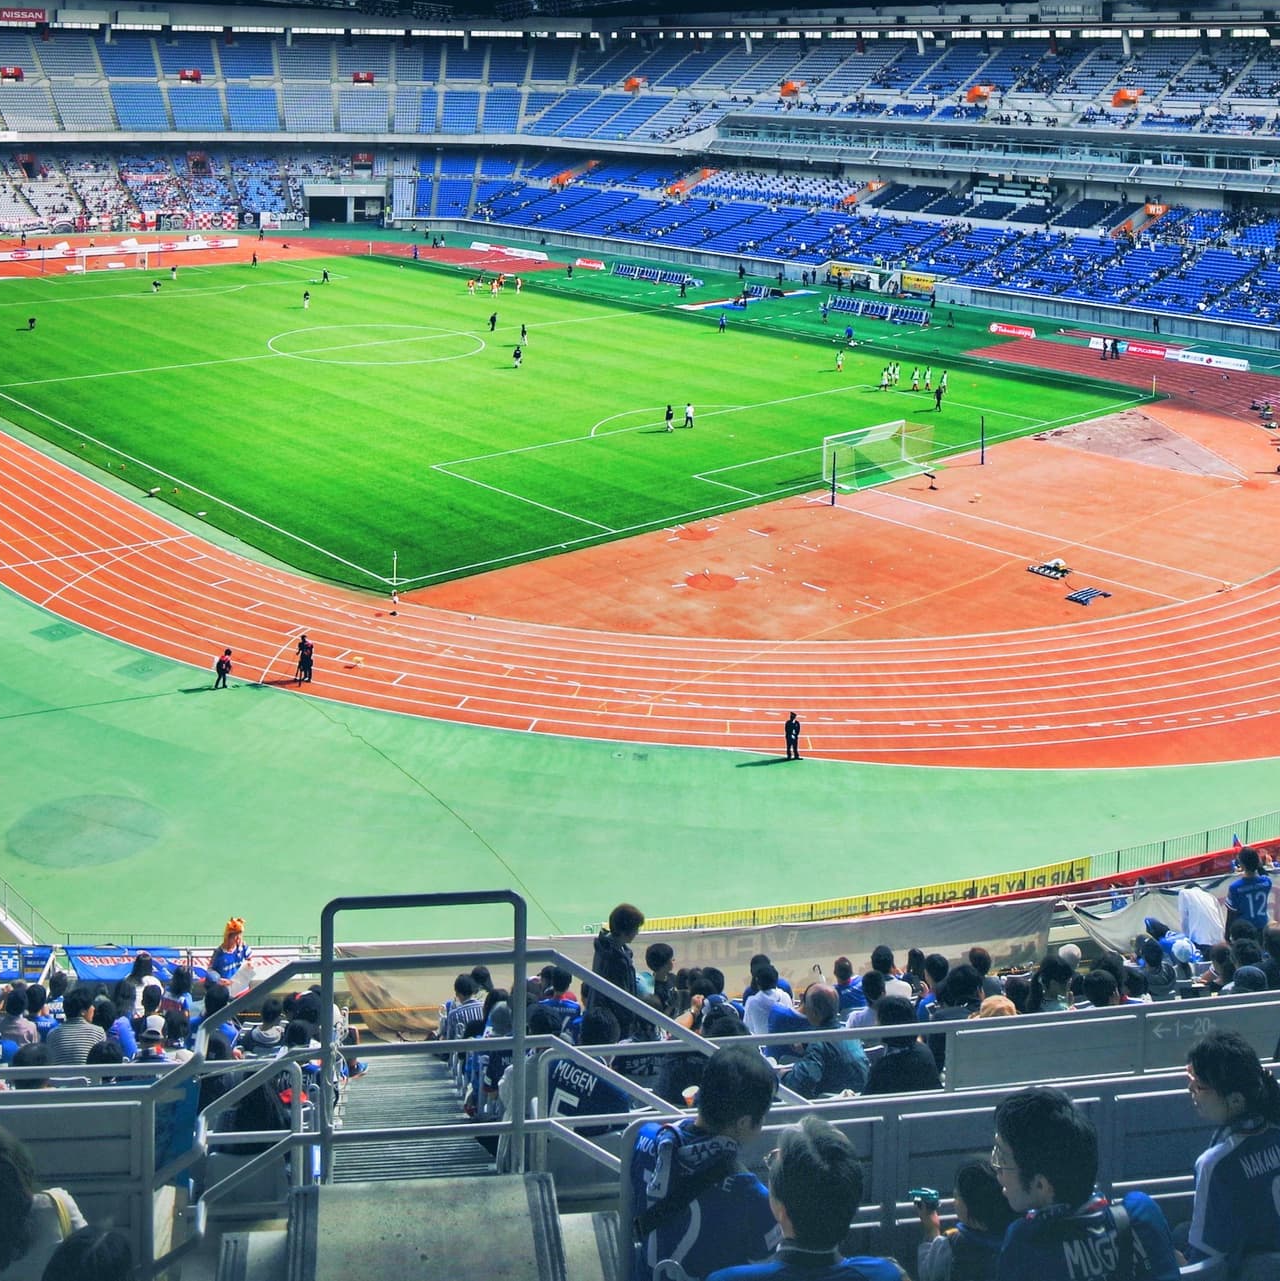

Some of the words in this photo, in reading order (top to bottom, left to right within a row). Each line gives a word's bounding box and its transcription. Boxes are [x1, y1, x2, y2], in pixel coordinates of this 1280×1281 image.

[2, 10, 43, 19] NISSAN
[1149, 204, 1163, 214] W13
[1246, 891, 1266, 918] 12
[554, 1059, 597, 1093] MUGEN
